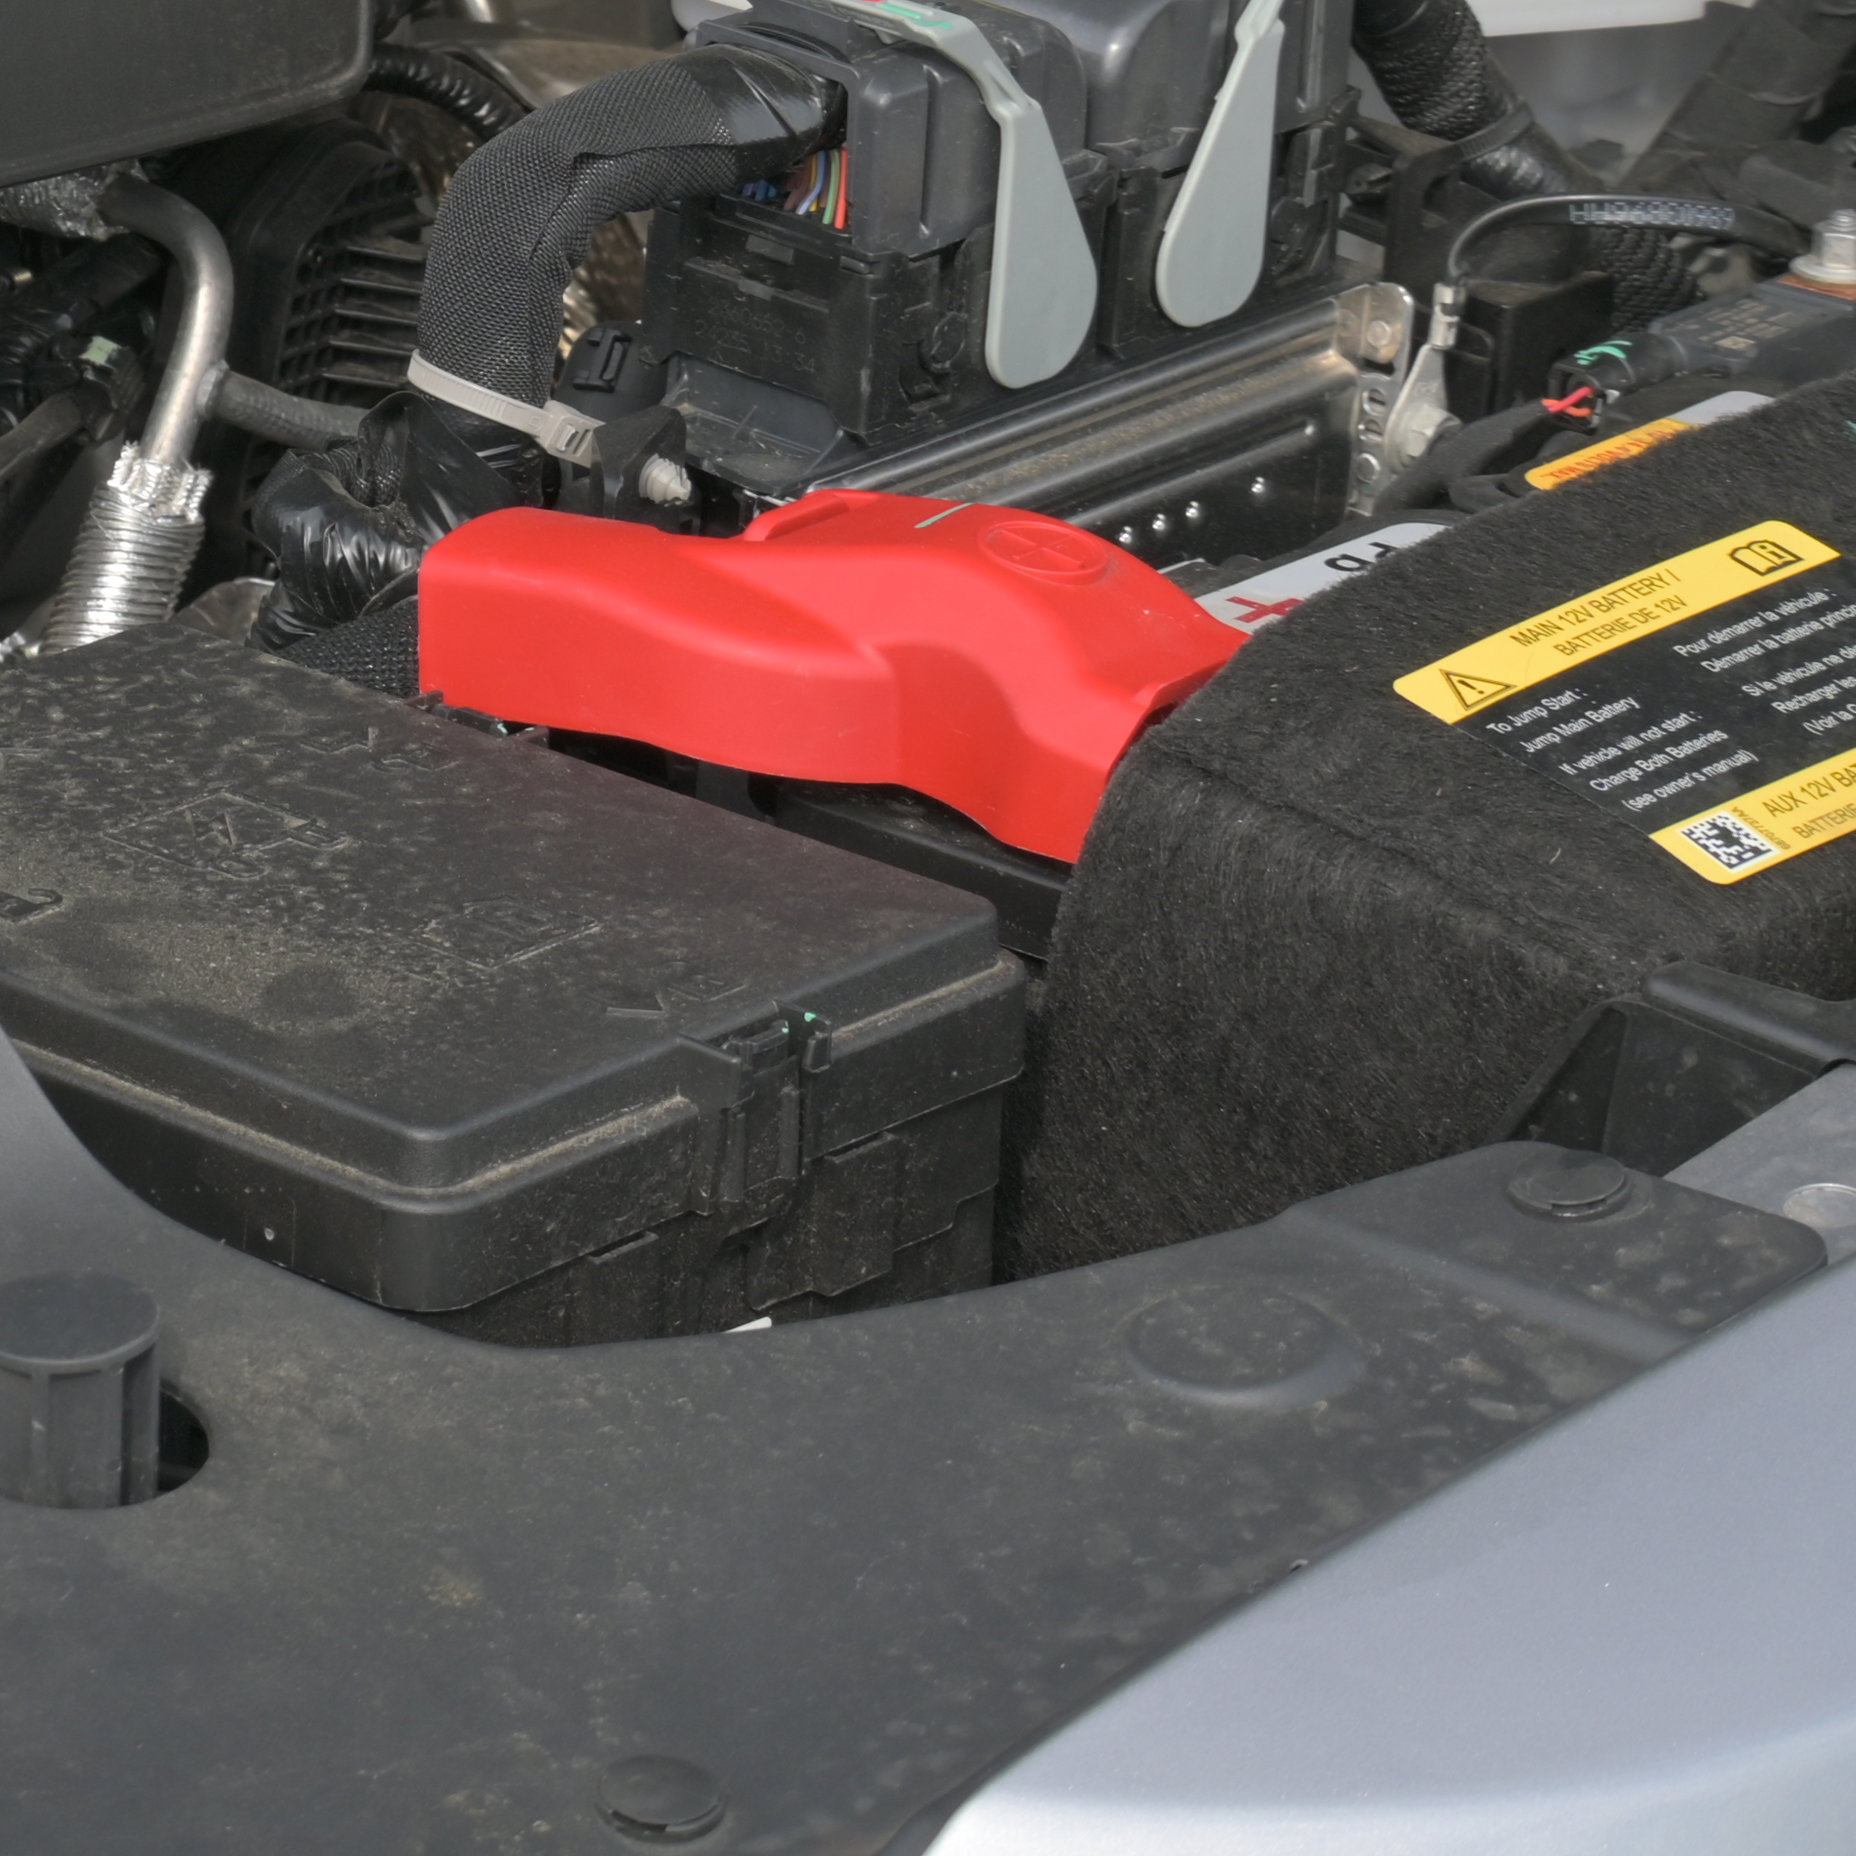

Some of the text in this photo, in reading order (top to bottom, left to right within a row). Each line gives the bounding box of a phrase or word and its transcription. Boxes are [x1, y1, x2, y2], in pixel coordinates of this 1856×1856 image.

[1509, 619, 1565, 648] MAIN
[1557, 605, 1596, 627] 12V
[1588, 572, 1667, 614] BATTERY
[1553, 595, 1688, 657] BATTERIE DE 12V
[1672, 638, 1712, 657] Pour
[1706, 615, 1767, 645] démarrer
[1757, 609, 1781, 623] la
[1774, 590, 1831, 616] véhicule
[1700, 643, 1766, 673] Démarrer
[1757, 638, 1781, 651] la
[1771, 620, 1825, 646] batterie
[1741, 682, 1764, 697] Si
[1755, 680, 1778, 693] le
[1772, 660, 1828, 686] véhicule
[1821, 652, 1845, 667] ne
[1486, 721, 1513, 735] To
[1507, 704, 1549, 728] Jump
[1541, 689, 1582, 712] Start
[1519, 696, 1641, 753] Jump Main Battery
[1770, 682, 1843, 714] Recharger
[1801, 710, 1841, 736] (Voir
[1559, 761, 1579, 776] If
[1576, 745, 1623, 771] vehicle
[1615, 733, 1645, 752] will
[1638, 725, 1668, 743] not
[1661, 711, 1697, 733] start
[1589, 728, 1730, 792] Charge Both Batteries
[1620, 748, 1760, 812] (see owner's manual)
[1761, 790, 1808, 818] AUX
[1799, 776, 1837, 801] 12V
